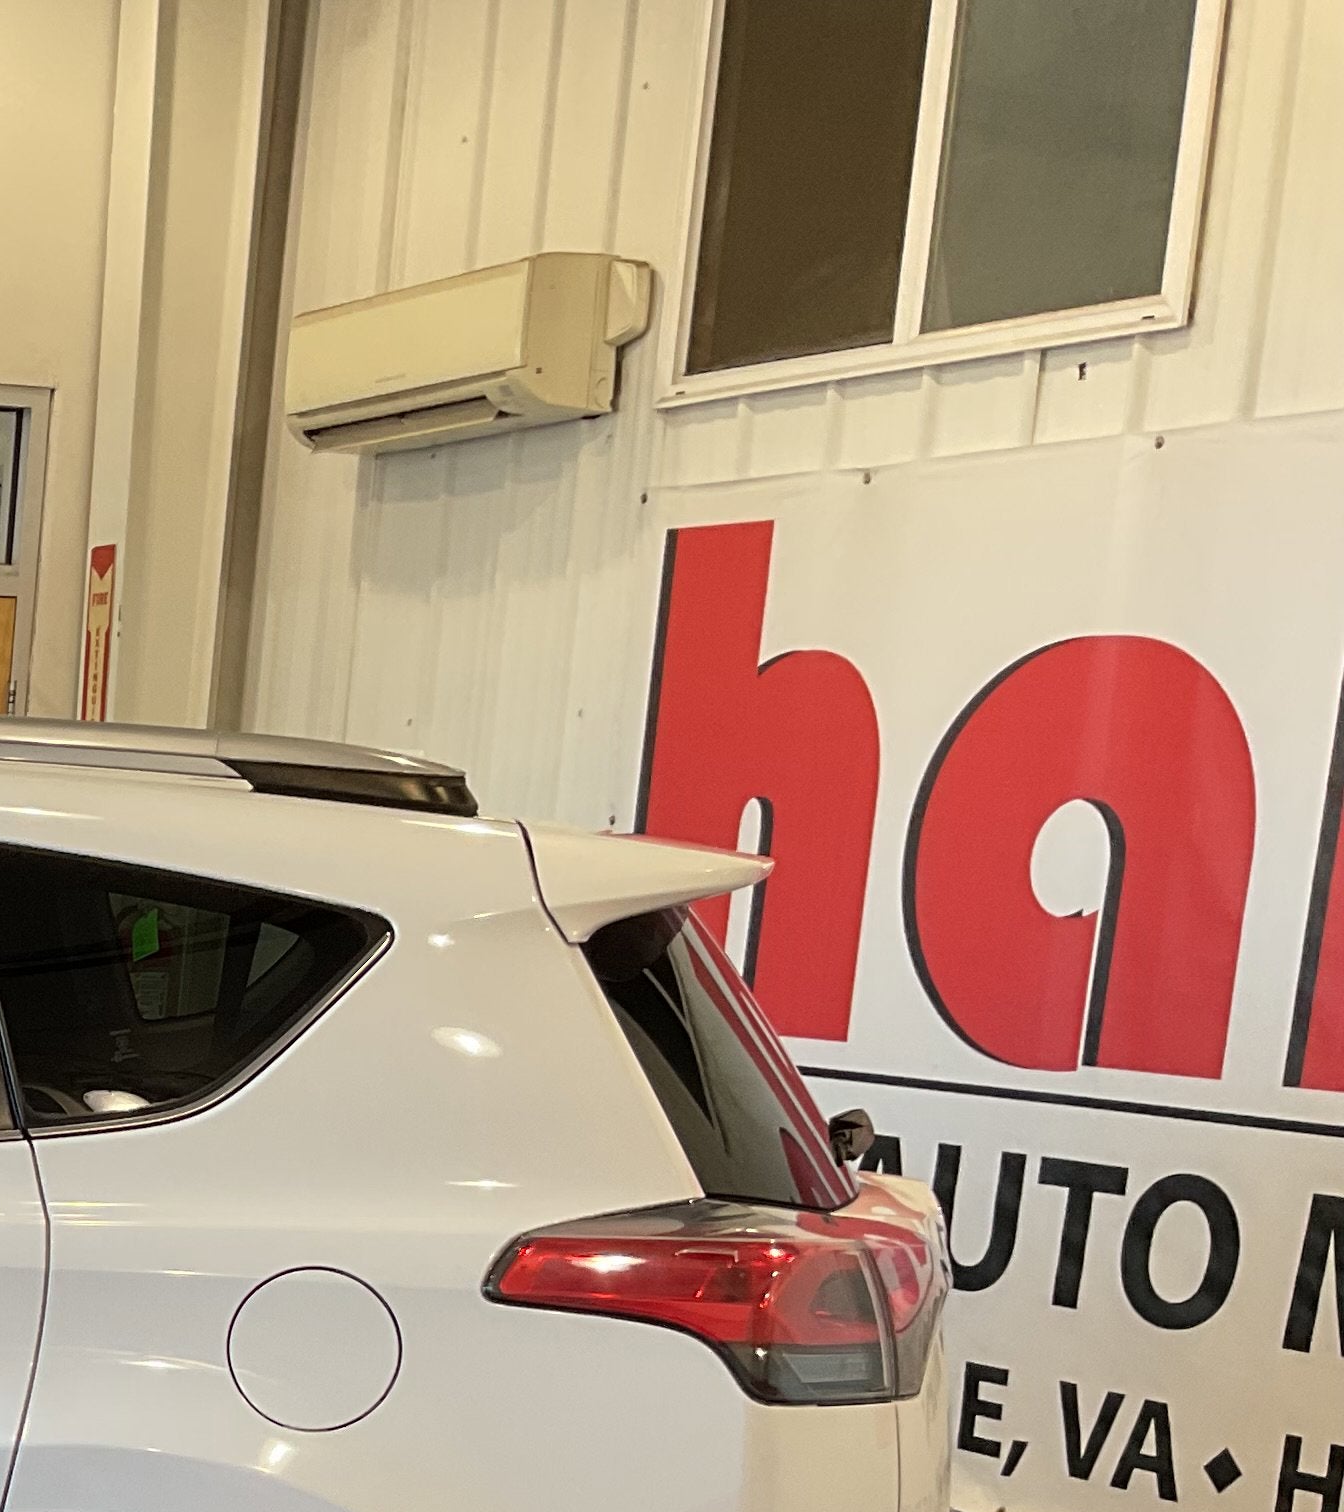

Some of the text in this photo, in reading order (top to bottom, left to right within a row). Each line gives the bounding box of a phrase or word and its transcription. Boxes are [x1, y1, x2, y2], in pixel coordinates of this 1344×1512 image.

[92, 592, 109, 606] FIRE
[633, 519, 1344, 1093] ha
[858, 1133, 1241, 1330] UTO
[1060, 1381, 1179, 1503] VA
